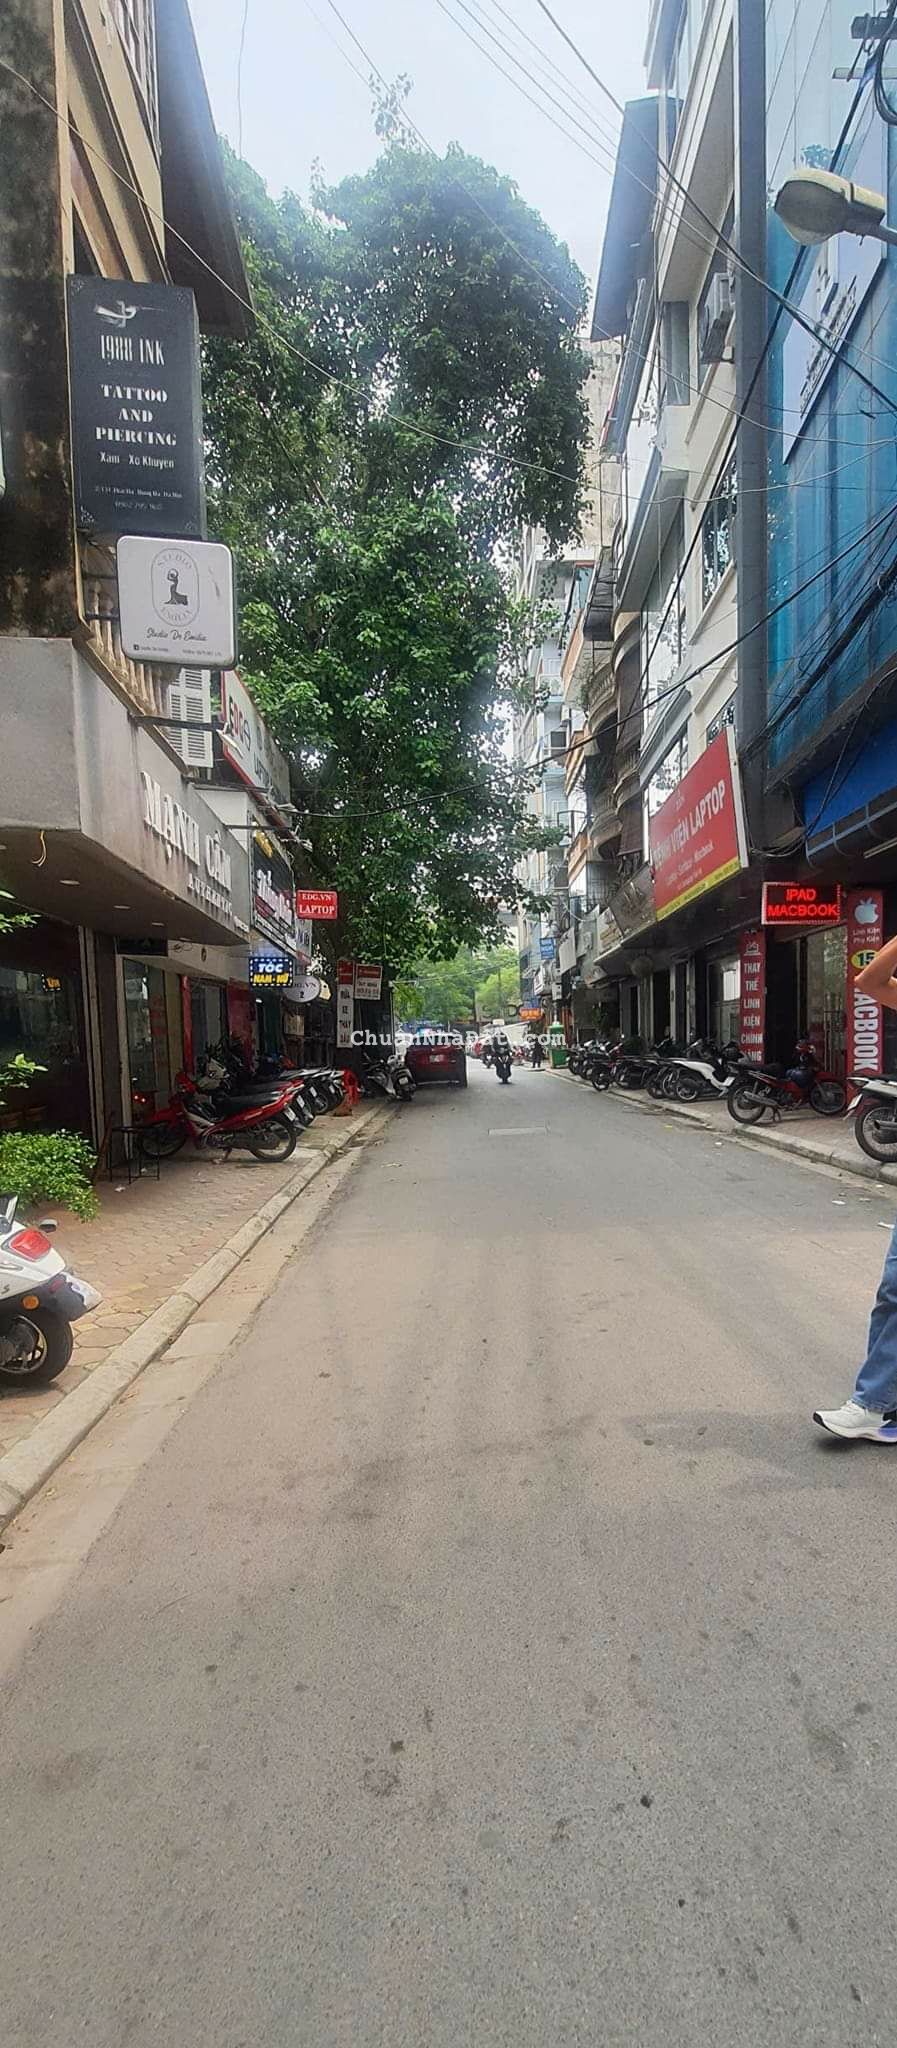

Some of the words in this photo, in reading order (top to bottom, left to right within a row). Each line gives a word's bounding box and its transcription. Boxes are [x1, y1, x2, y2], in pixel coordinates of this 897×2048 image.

[101, 335, 133, 361] 1988
[140, 338, 165, 366] INK
[101, 384, 168, 403] TATTOO
[119, 408, 153, 422] AND
[96, 427, 177, 446] PIERCING
[671, 817, 689, 857] VIỆN
[688, 778, 726, 836] LAPTOP
[302, 893, 332, 901] EDG.VN
[786, 888, 816, 901] IPAD
[299, 904, 335, 915] LAPTOP
[767, 904, 838, 917] MACBOOK
[259, 961, 283, 973] TÓC
[744, 963, 760, 974] THAY
[253, 974, 273, 984] NAM
[744, 999, 760, 1009] LINH
[744, 1014, 760, 1027] KIỆN
